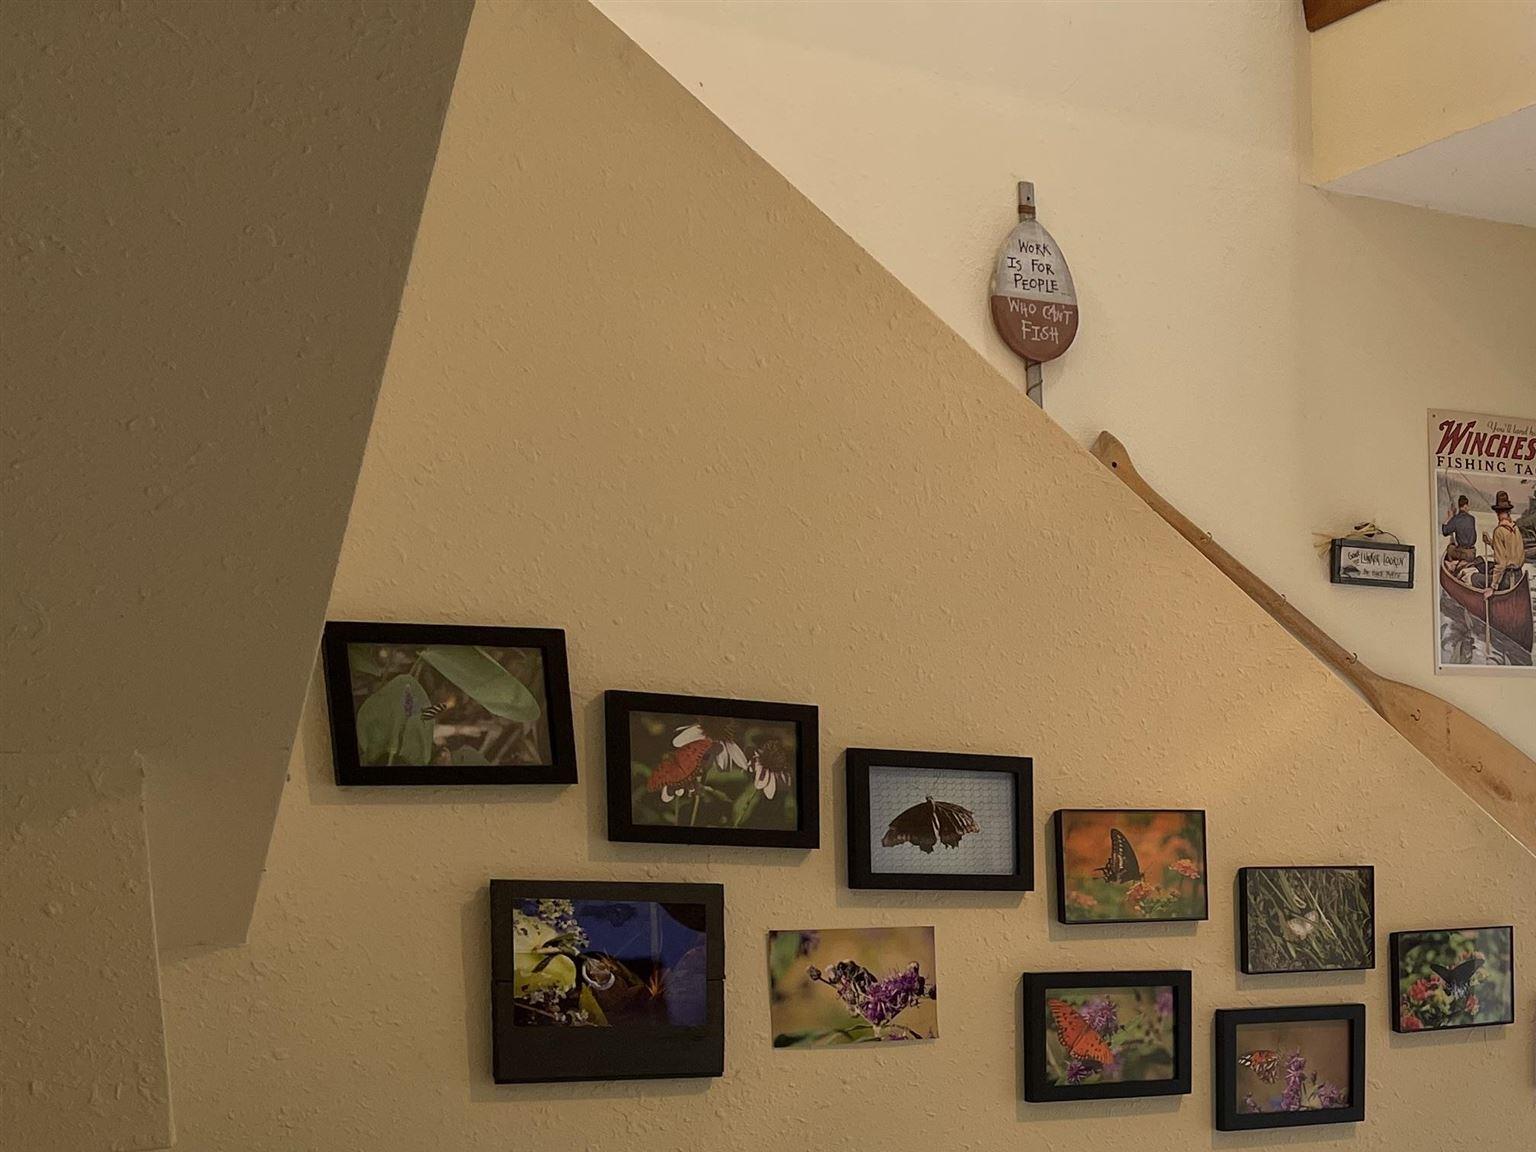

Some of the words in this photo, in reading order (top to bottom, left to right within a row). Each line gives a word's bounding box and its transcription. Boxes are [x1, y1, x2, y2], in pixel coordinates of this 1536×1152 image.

[1018, 239, 1052, 257] WORK
[1007, 256, 1022, 271] IS
[1031, 259, 1055, 275] FOR
[1013, 273, 1059, 293] PEOPLE
[1008, 296, 1037, 317] WHO
[1042, 304, 1073, 325] CAN'T
[1021, 319, 1059, 344] FISH
[1437, 456, 1506, 473] FISHING
